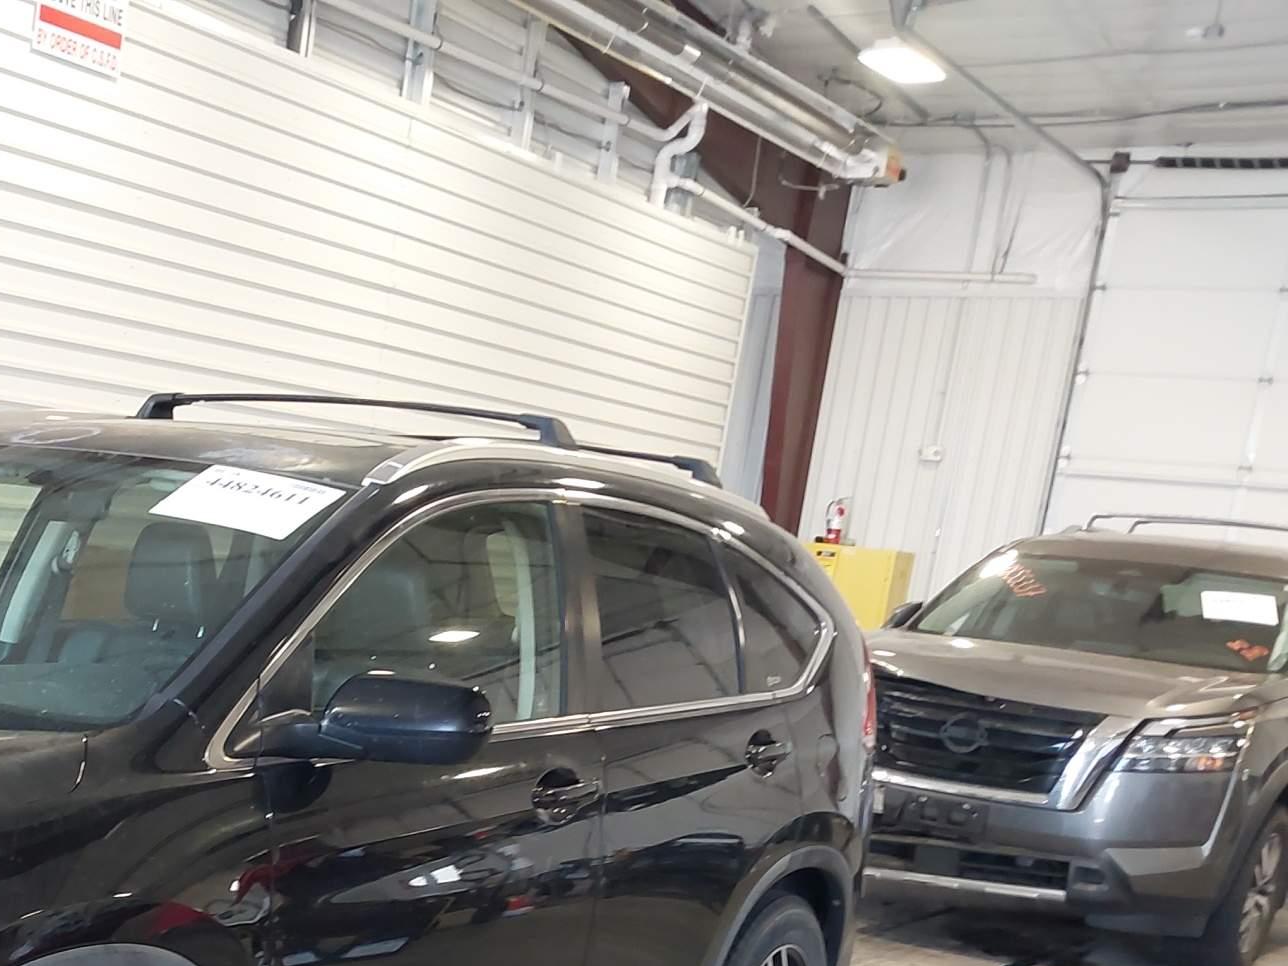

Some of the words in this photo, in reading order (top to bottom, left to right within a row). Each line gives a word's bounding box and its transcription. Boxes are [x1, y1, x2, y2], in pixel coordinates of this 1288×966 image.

[103, 3, 124, 27] LINE
[50, 33, 77, 55] ORDER
[206, 477, 310, 505] 44824611
